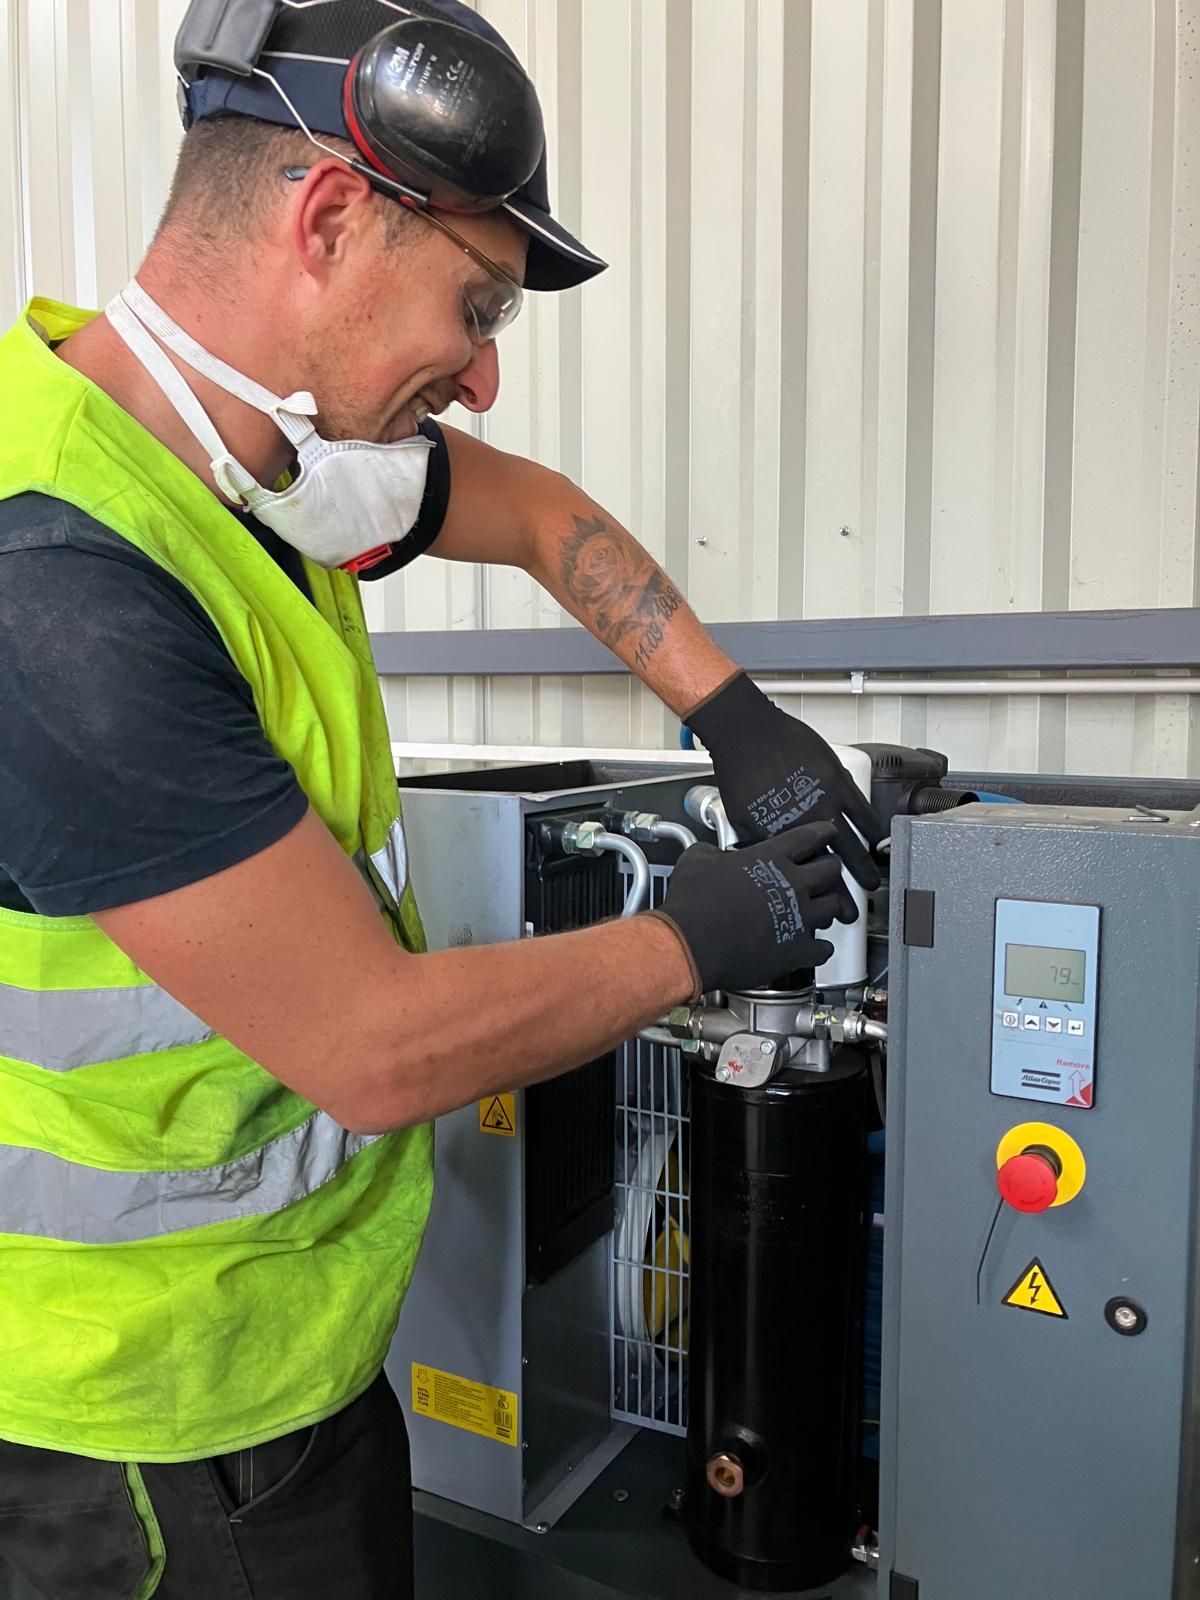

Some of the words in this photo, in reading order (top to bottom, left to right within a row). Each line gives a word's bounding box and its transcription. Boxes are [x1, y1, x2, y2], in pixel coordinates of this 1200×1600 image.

[1048, 965, 1072, 986] 79
[1056, 1059, 1089, 1069] Remove
[1021, 1074, 1041, 1085] Atlas
